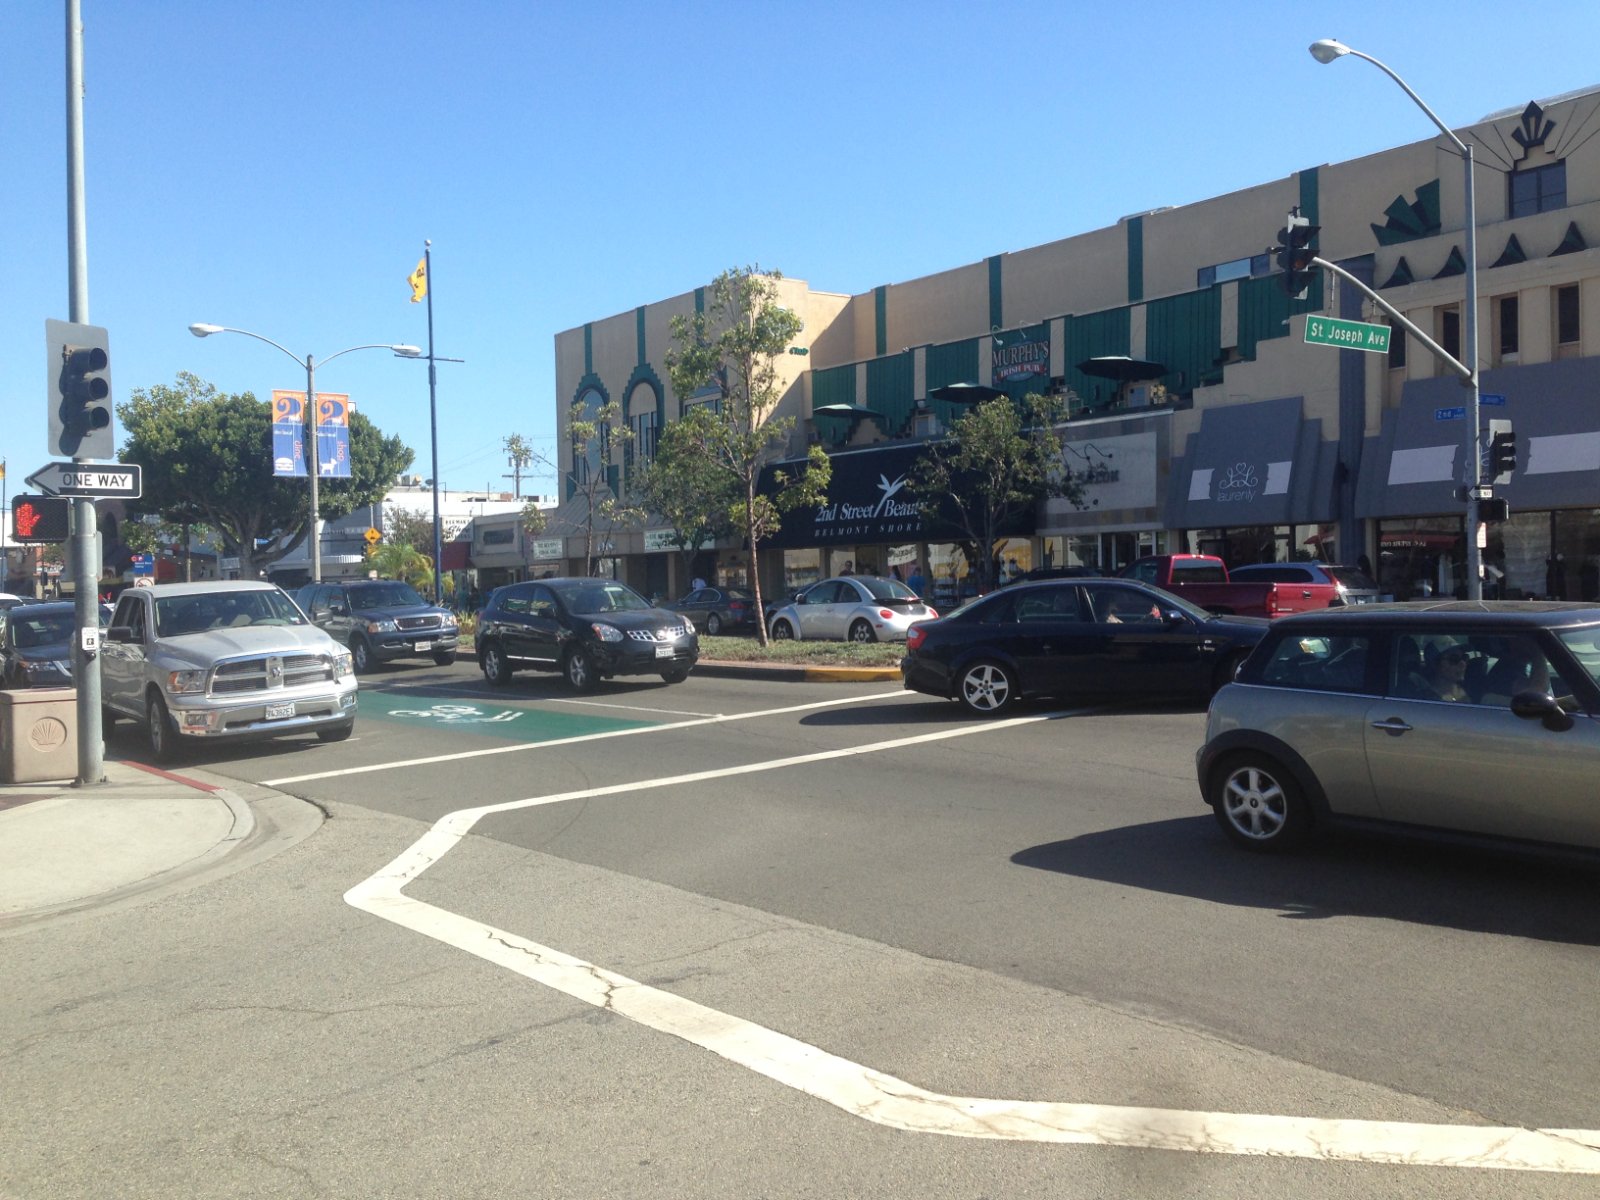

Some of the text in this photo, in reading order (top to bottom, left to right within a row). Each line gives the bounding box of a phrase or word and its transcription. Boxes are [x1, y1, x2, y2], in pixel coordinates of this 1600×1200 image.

[1311, 322, 1385, 346] St Joseph Ave
[992, 341, 1049, 367] MURPHY'S
[1000, 364, 1040, 377] IRISH PUB
[337, 441, 347, 461] shop
[62, 473, 128, 487] ONE WAY
[815, 503, 838, 522] 2nd
[840, 502, 875, 520] Street
[814, 523, 921, 537] BELMONT SHORE
